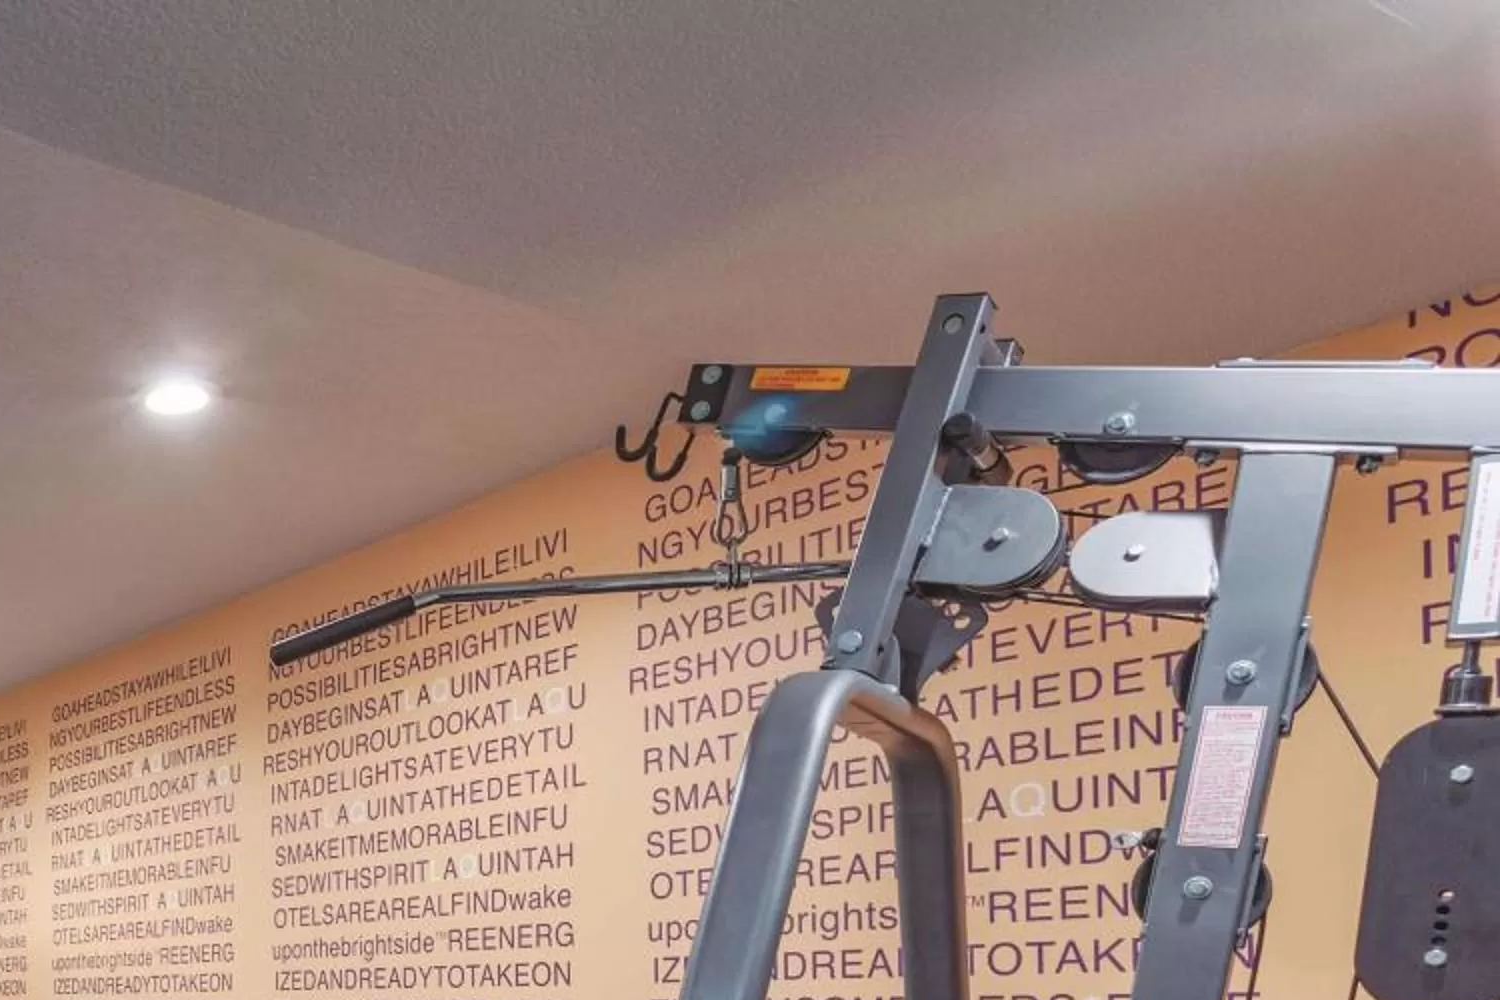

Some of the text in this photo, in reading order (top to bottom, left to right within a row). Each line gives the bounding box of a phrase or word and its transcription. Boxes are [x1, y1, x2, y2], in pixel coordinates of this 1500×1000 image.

[267, 605, 578, 713] POSSIBILITIESABRIGHTNEW
[271, 723, 574, 805] INTADELIGHTSATEVERYTU
[275, 804, 568, 867] SMAKEITMEMORABLEINFU
[272, 884, 572, 929] OTELSAREAREALFINDwake
[275, 961, 572, 991] IZEDANDREADYTOTAKEON
